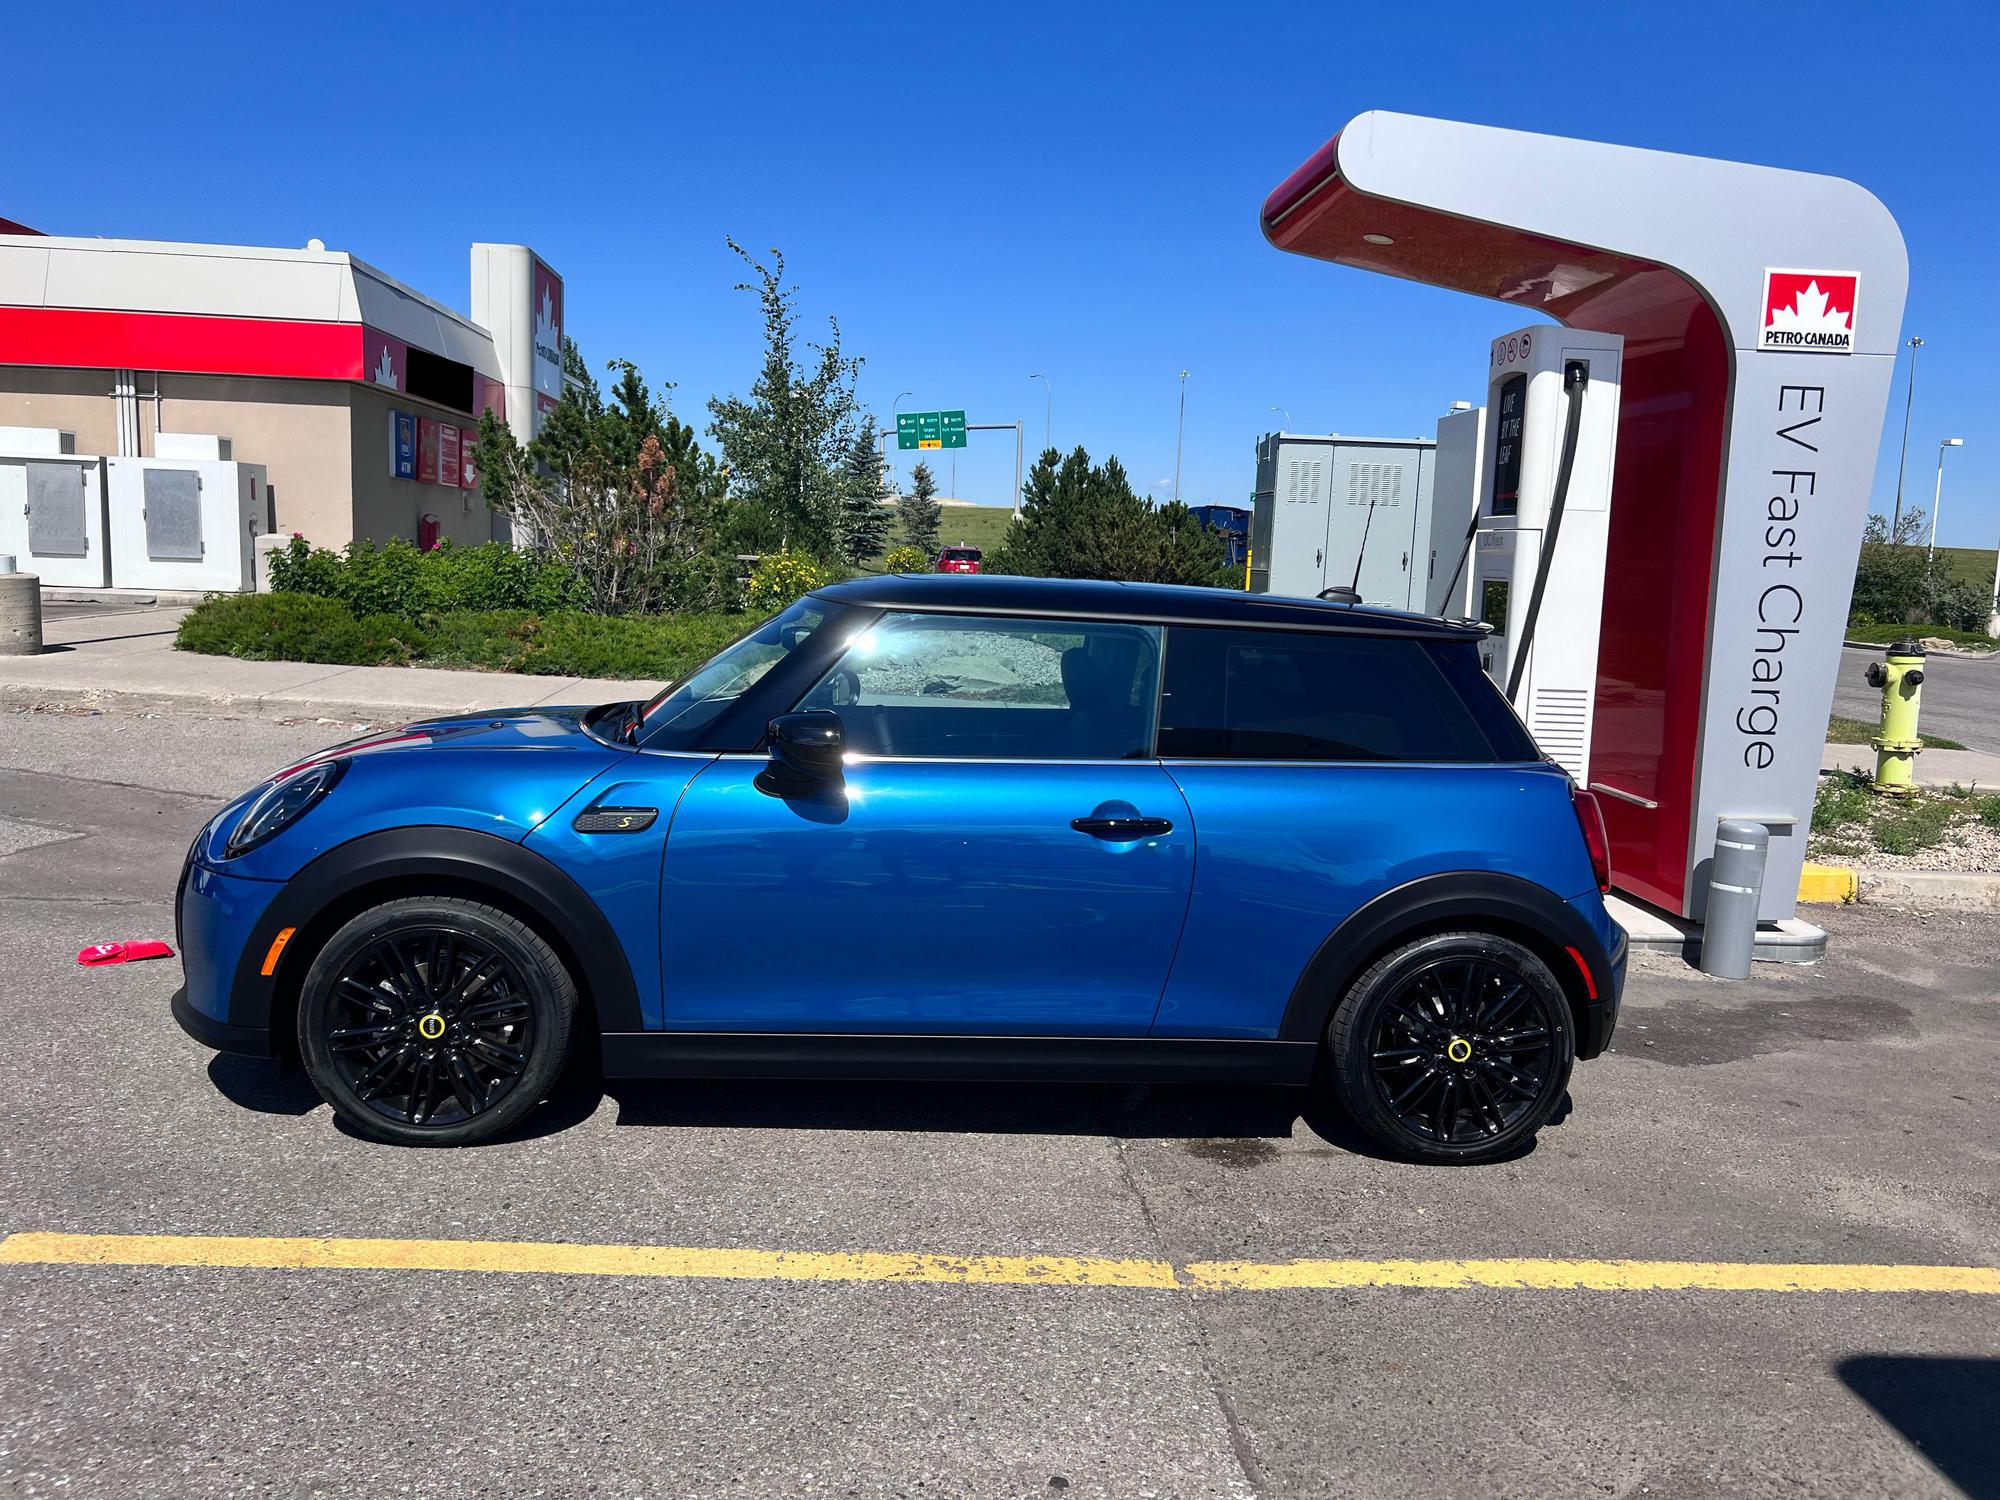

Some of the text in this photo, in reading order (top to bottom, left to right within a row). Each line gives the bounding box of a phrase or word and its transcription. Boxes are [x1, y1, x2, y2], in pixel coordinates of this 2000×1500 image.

[1766, 331, 1850, 346] PETRO-CANADA
[1503, 393, 1516, 414] LIVE
[1499, 445, 1512, 465] LEAF
[401, 461, 411, 473] ATM
[1736, 385, 1825, 770] EV Fast Charge
[618, 817, 633, 828] S
